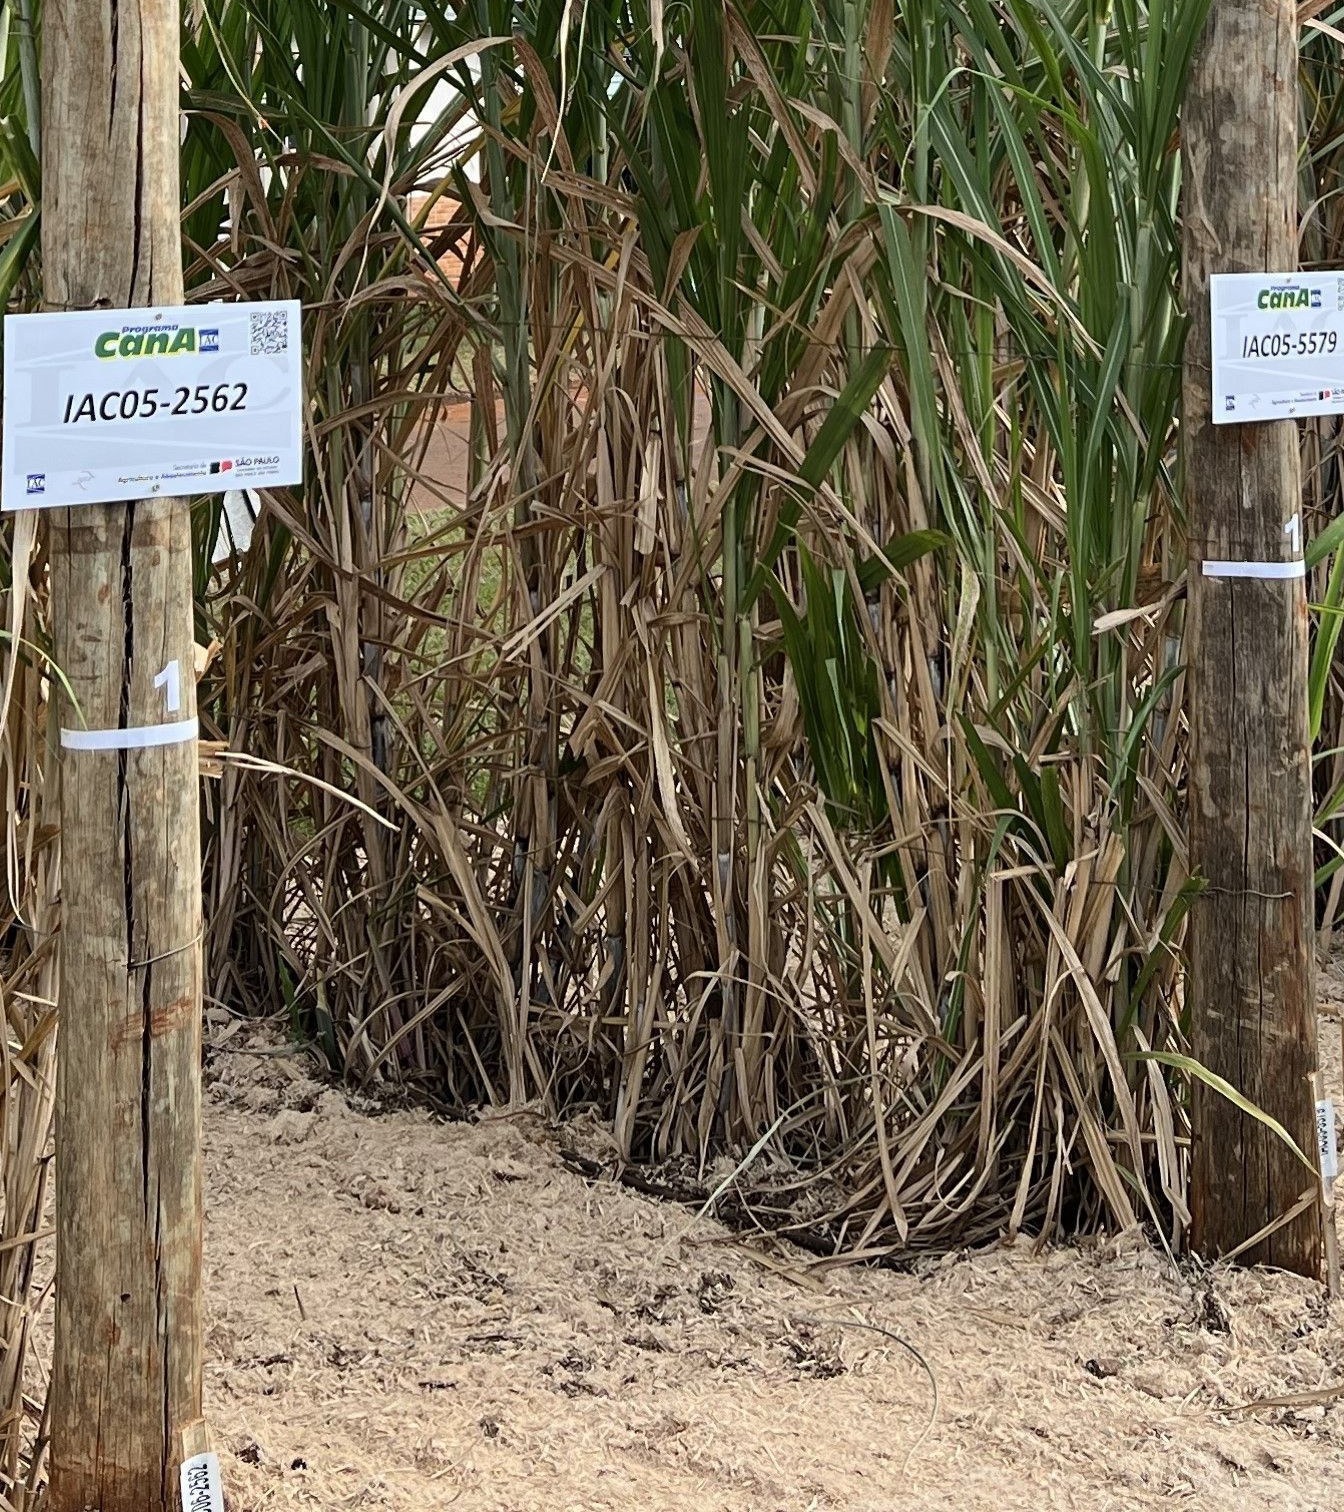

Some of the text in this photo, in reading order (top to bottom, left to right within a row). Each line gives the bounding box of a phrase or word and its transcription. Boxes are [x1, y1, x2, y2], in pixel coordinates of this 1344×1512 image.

[1242, 330, 1338, 359] IAC05-5579
[62, 381, 249, 424] IAC05-2562
[1284, 512, 1300, 553] 1
[154, 659, 181, 713] 1
